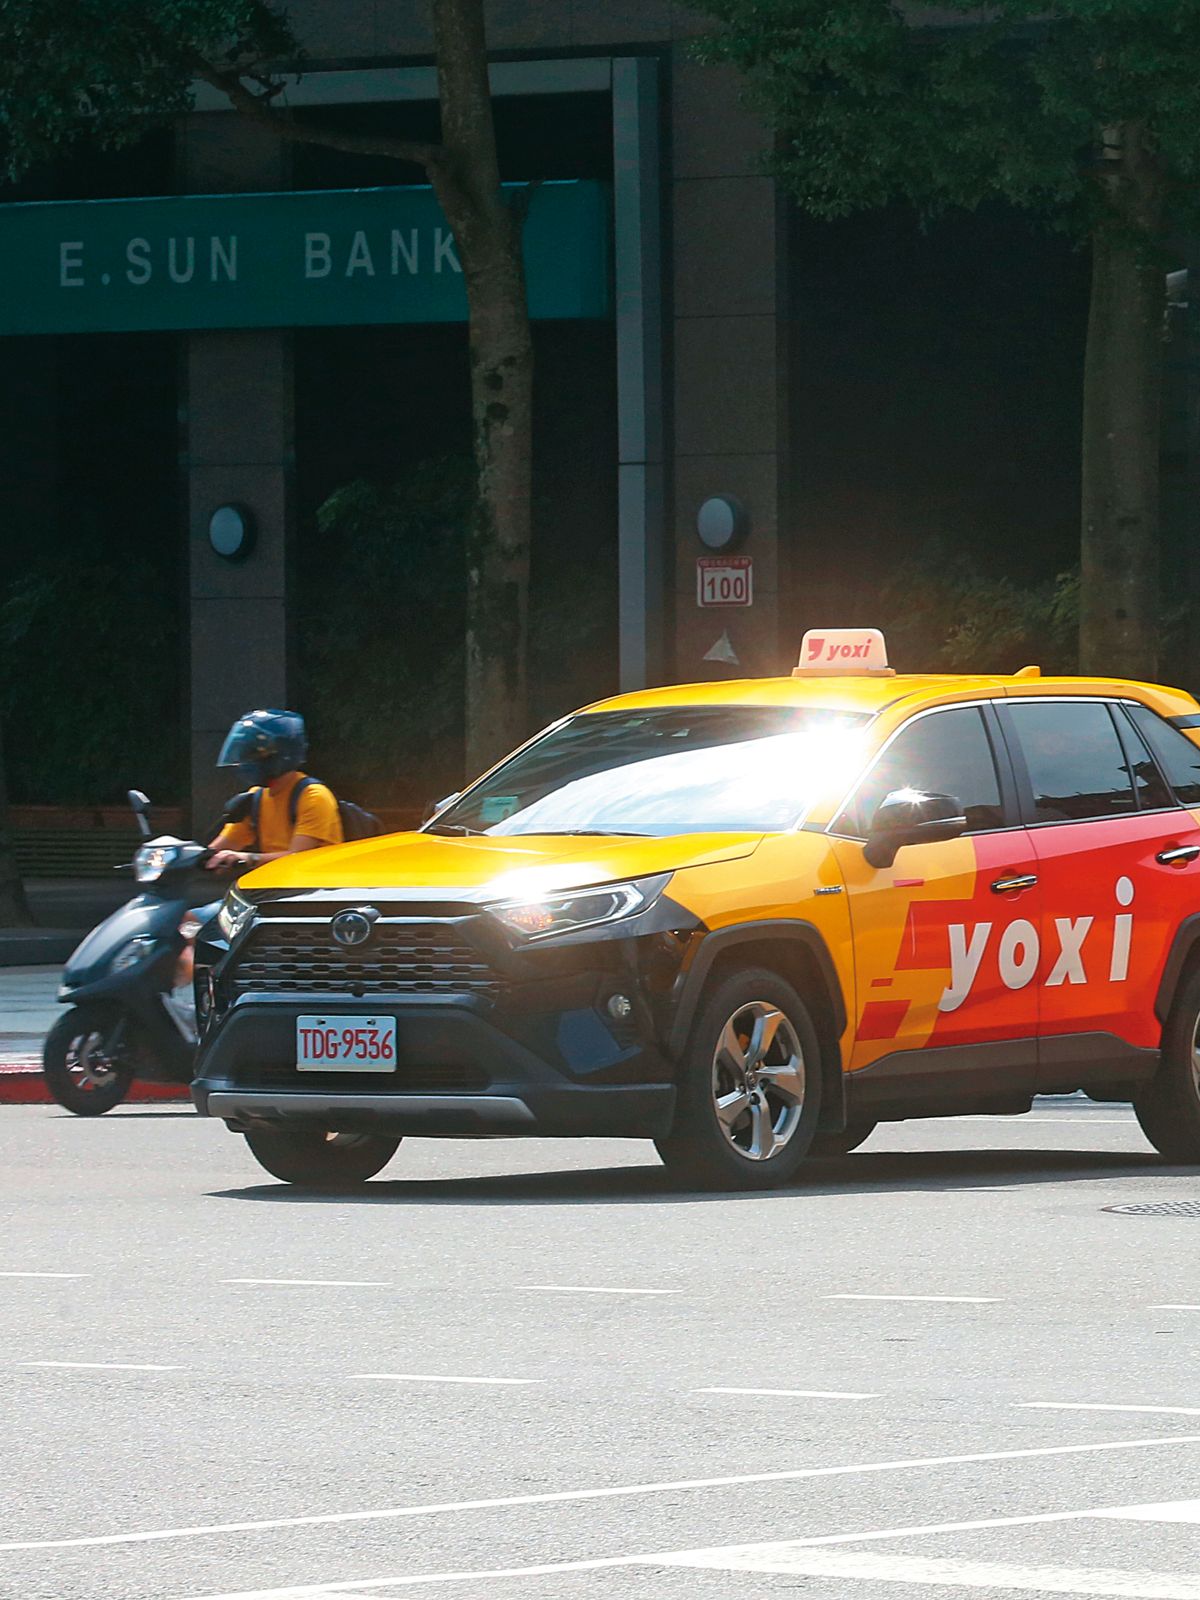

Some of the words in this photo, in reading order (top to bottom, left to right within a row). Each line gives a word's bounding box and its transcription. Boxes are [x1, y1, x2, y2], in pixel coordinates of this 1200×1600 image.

[59, 235, 239, 287] E.SUN
[304, 227, 463, 279] BANK
[707, 577, 745, 600] 100
[827, 638, 873, 661] yoxi
[938, 876, 1134, 1012] yoxi
